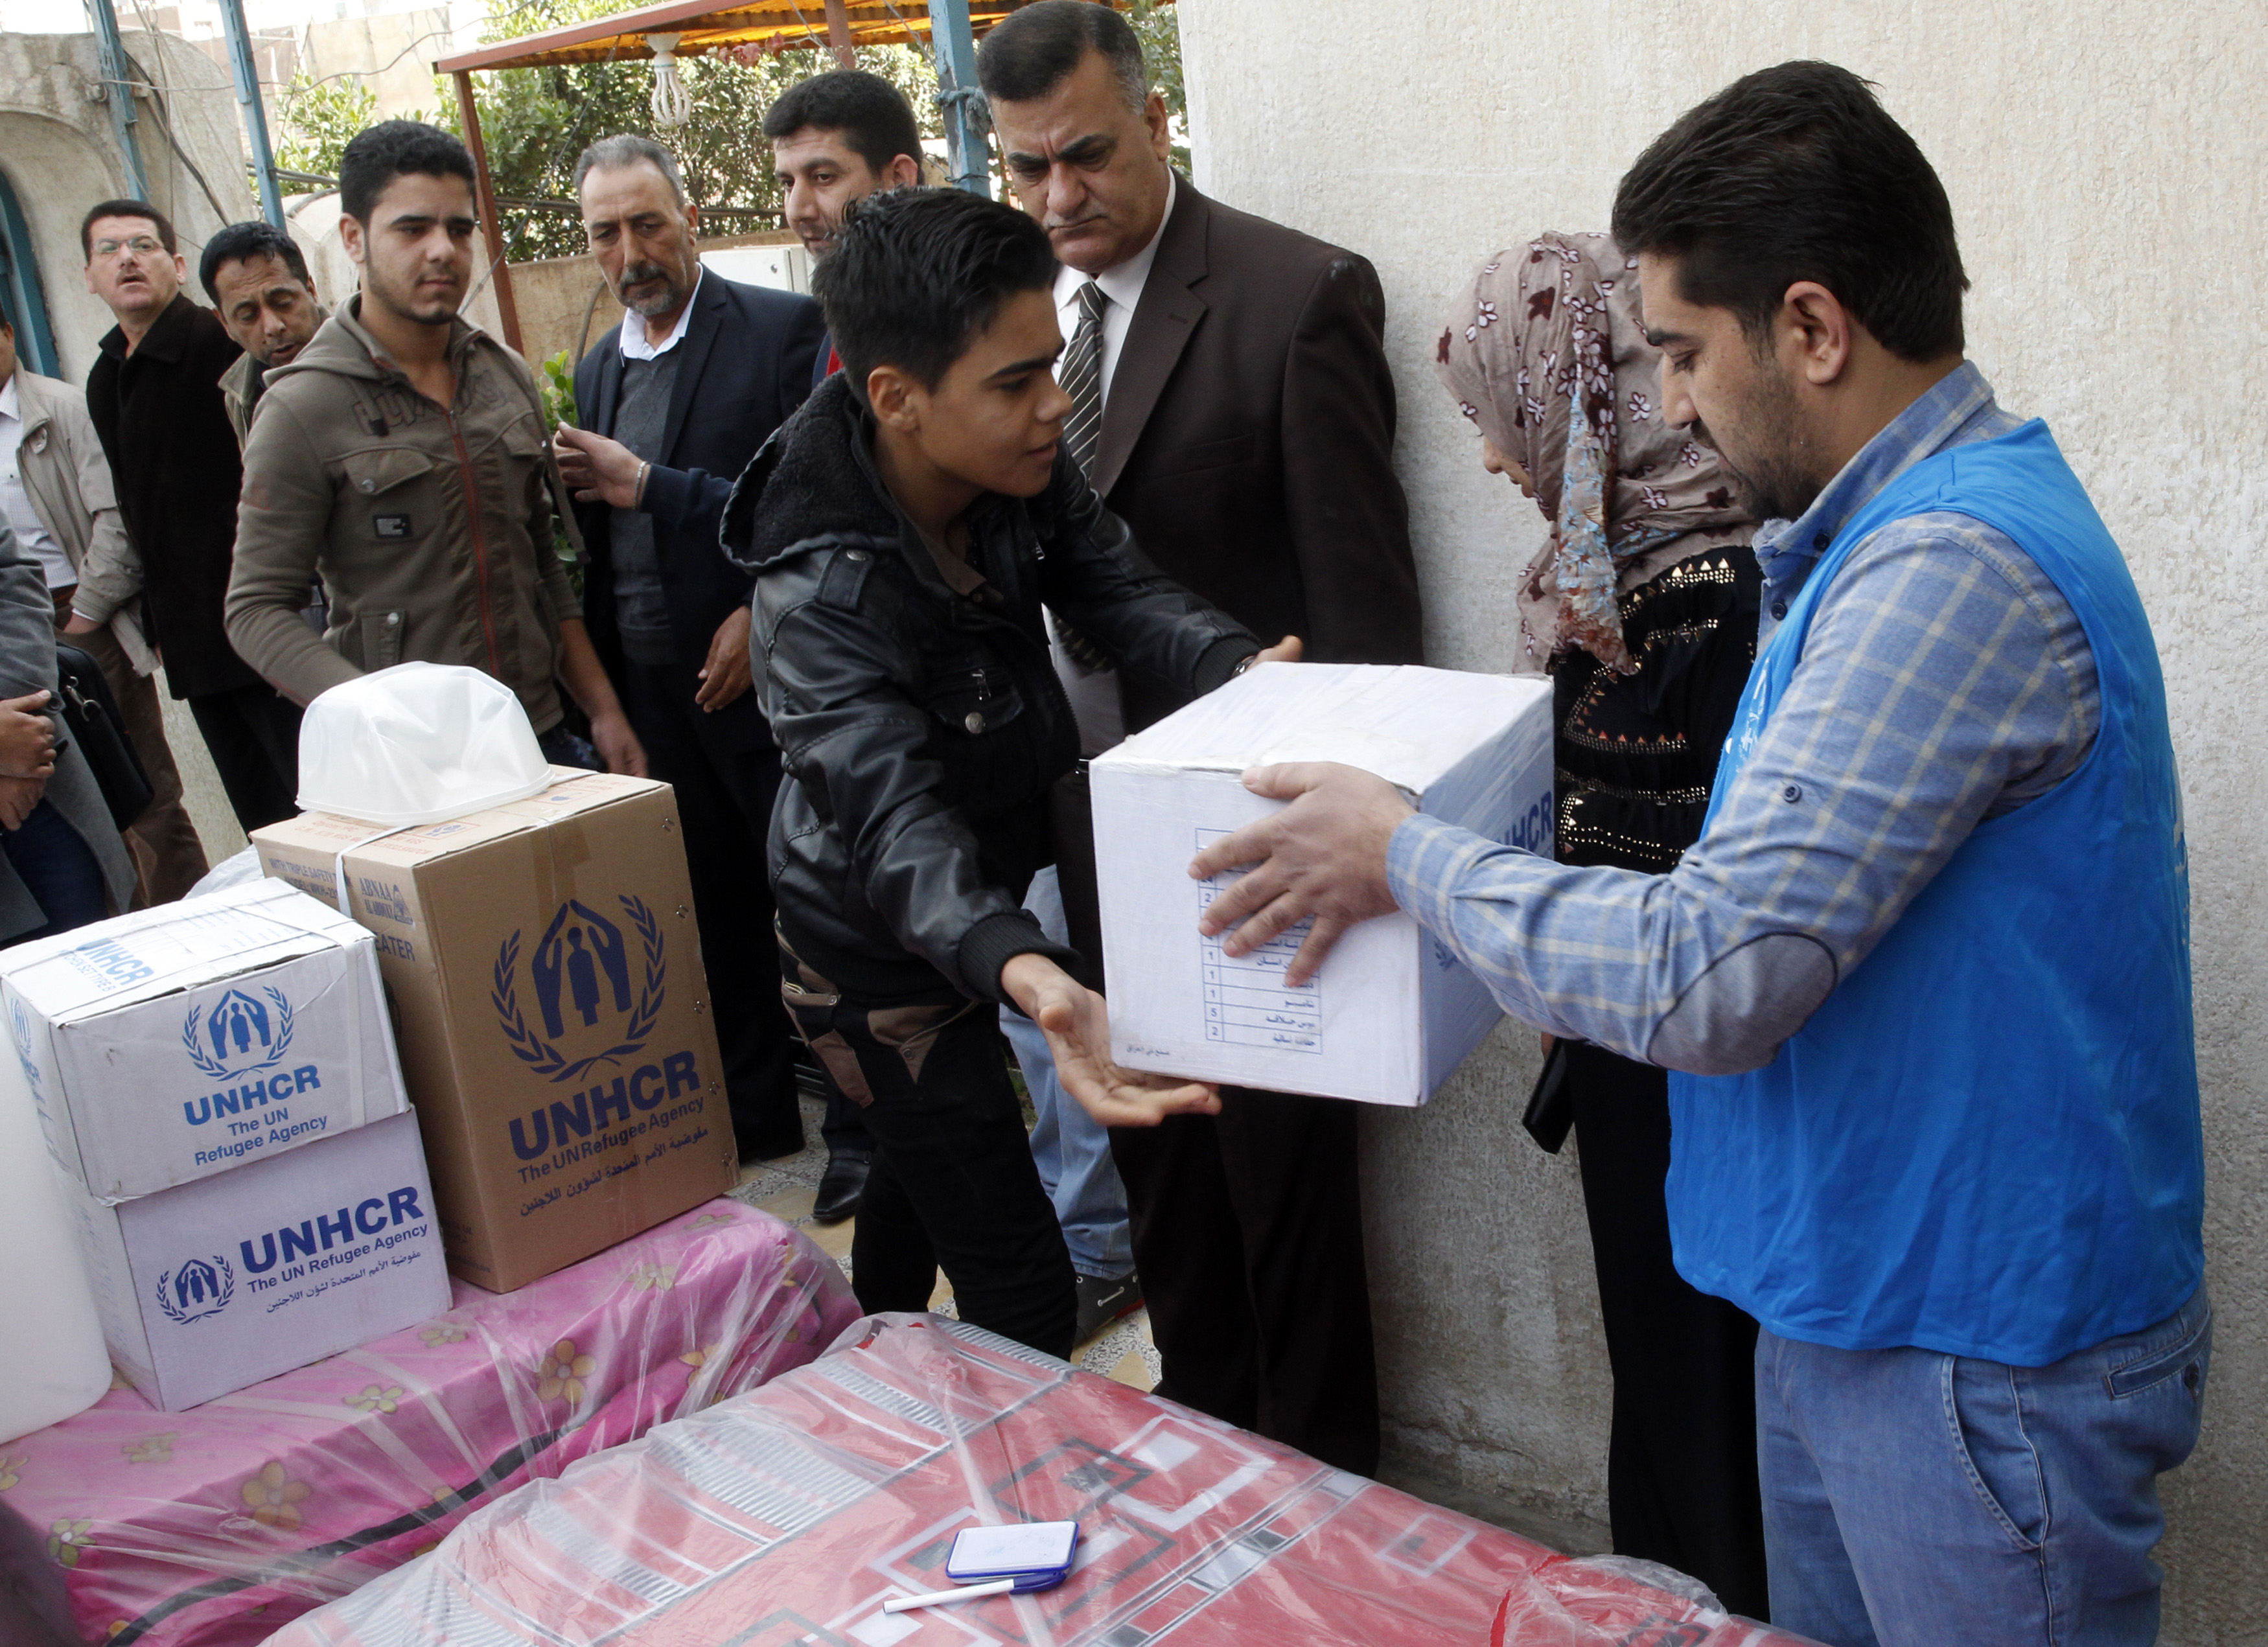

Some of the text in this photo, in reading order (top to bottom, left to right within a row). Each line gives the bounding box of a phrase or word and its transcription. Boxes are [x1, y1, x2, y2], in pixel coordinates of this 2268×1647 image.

[1498, 791, 1553, 852] HCR
[308, 866, 334, 884] SAFETY
[1210, 1008, 1218, 1017] 5
[1212, 1026, 1219, 1037] 2
[183, 1065, 321, 1125] UNHCR
[508, 1050, 700, 1160] UNHCR
[195, 1116, 328, 1166] Refugee Agency
[227, 1107, 289, 1136] The UN
[518, 1096, 704, 1184] The UN Refugee Agency
[520, 1126, 708, 1217] مفوضية الأمم المتحدة لشؤون اللاجئين
[240, 1186, 424, 1274] UNHCR
[247, 1276, 278, 1294] The
[281, 1265, 305, 1282] UN
[308, 1244, 371, 1274] Refugee
[374, 1224, 428, 1252] Agency
[330, 1269, 366, 1287] المتحدة
[368, 1261, 389, 1278] الأمم
[391, 1252, 421, 1268] مفوضية
[266, 1291, 303, 1313] اللاجئين
